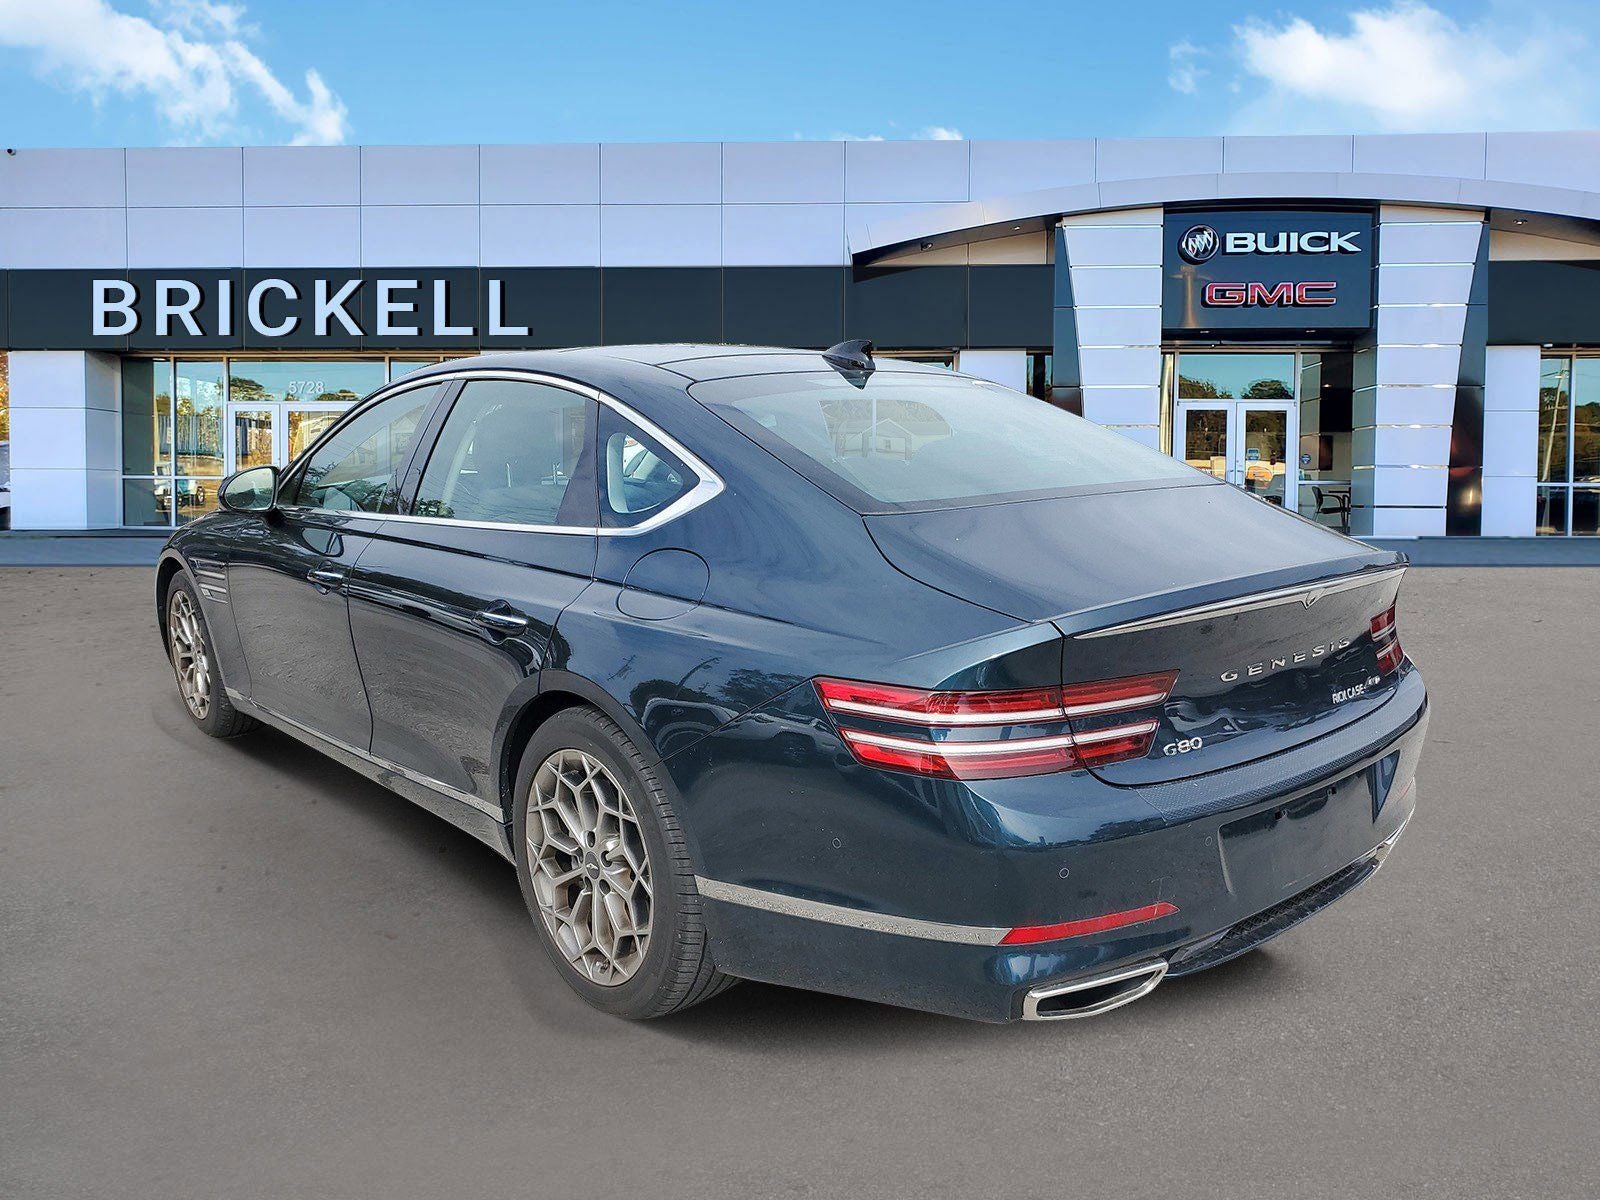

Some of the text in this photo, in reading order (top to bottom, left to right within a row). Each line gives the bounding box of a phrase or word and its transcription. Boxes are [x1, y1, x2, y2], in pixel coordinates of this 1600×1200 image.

[1226, 231, 1362, 252] BUICK
[1205, 281, 1337, 305] GMC
[92, 278, 530, 337] BRICKELL
[288, 380, 325, 395] 5728
[1220, 636, 1351, 682] GENESIS
[1347, 684, 1365, 698] CASE
[1163, 736, 1203, 756] G80
